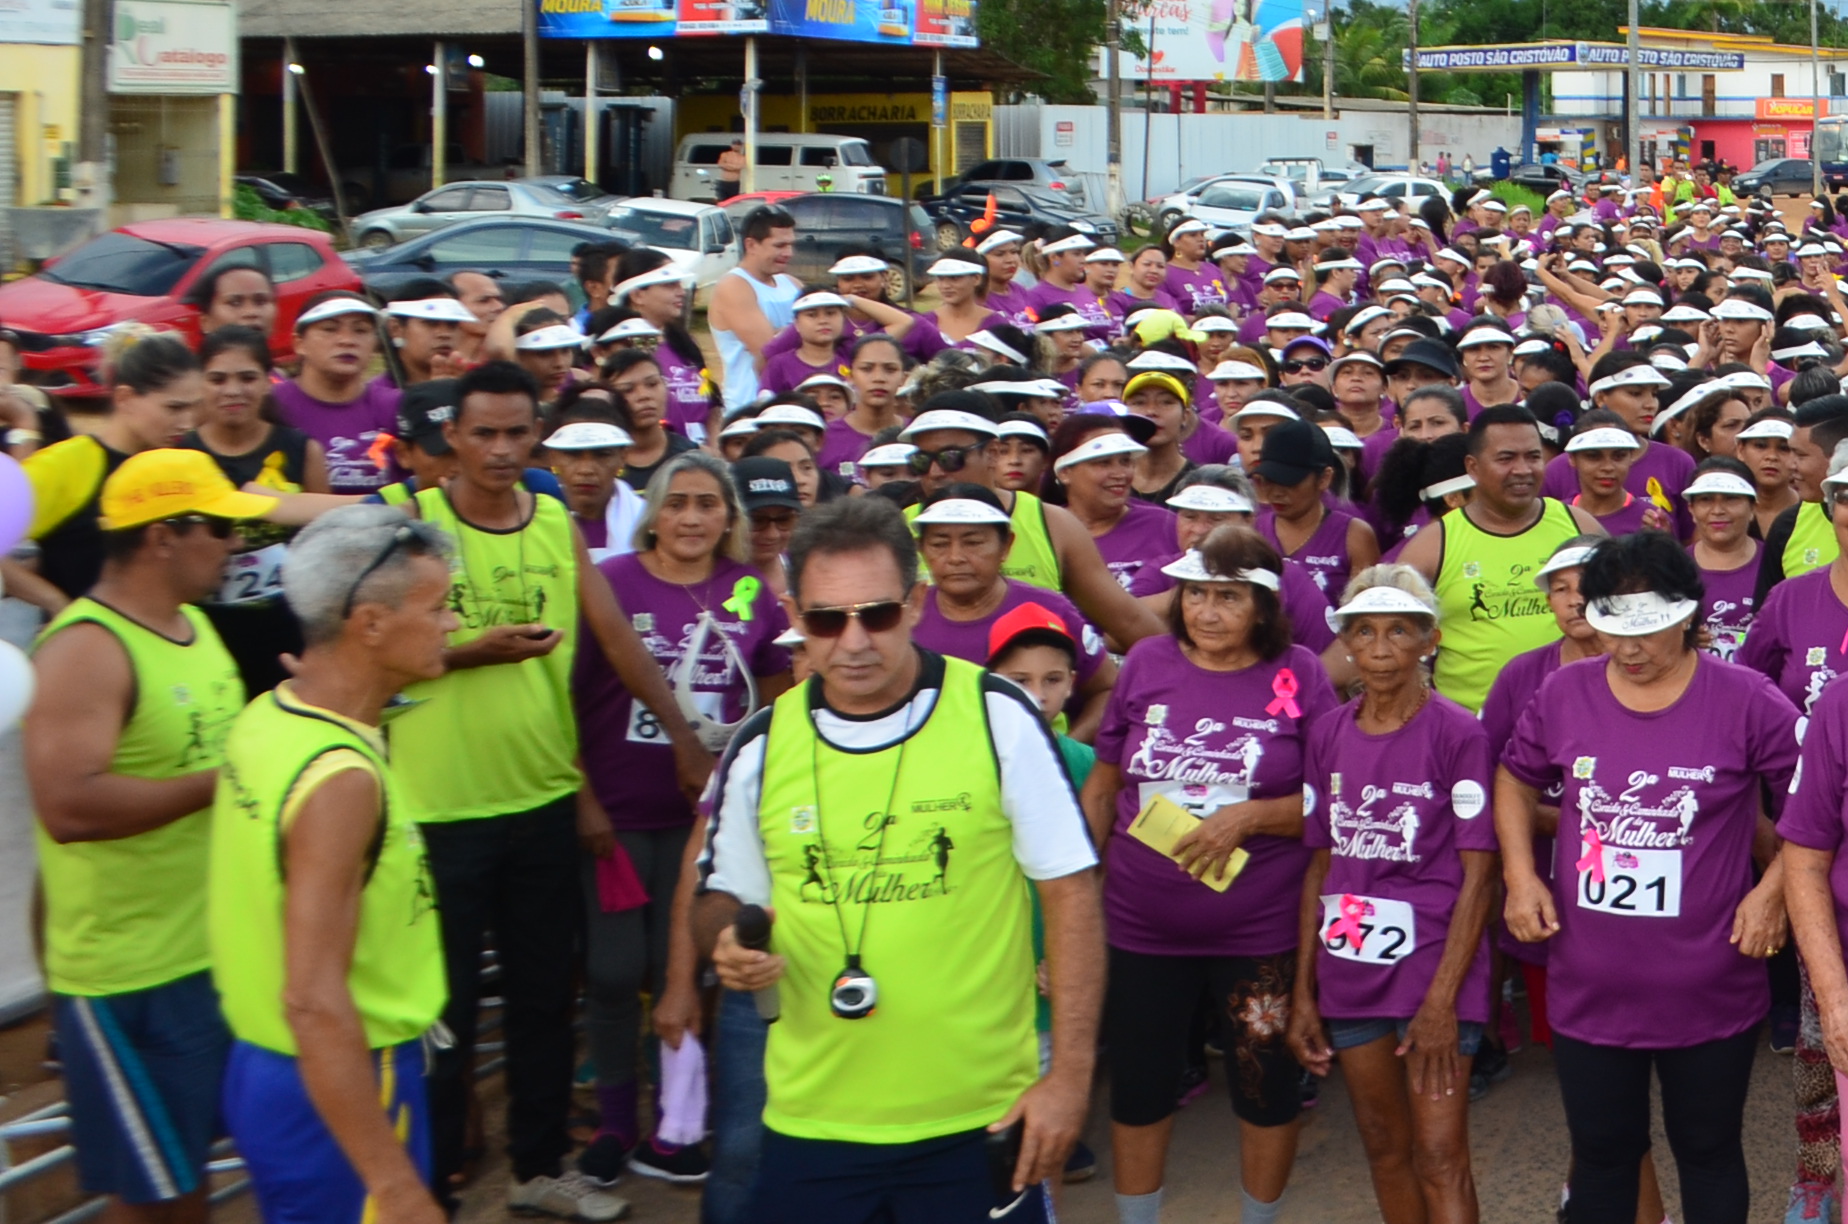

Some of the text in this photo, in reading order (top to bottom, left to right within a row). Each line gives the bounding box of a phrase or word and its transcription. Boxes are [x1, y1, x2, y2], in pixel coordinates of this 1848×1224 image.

[1418, 45, 1570, 67] AUTO POSTO SÃO CRISTÓVÃO
[1589, 47, 1739, 68] AUTO PSTO SÃO CRISTÓVÃO
[809, 105, 917, 122] BORRACHARIA
[1146, 756, 1240, 784] Mulher
[1667, 768, 1704, 781] MULHER
[912, 803, 957, 814] MULHER
[1596, 816, 1678, 848] Mulher
[1337, 831, 1401, 862] Mulher
[822, 871, 932, 905] Mulher
[1584, 868, 1667, 912] 021
